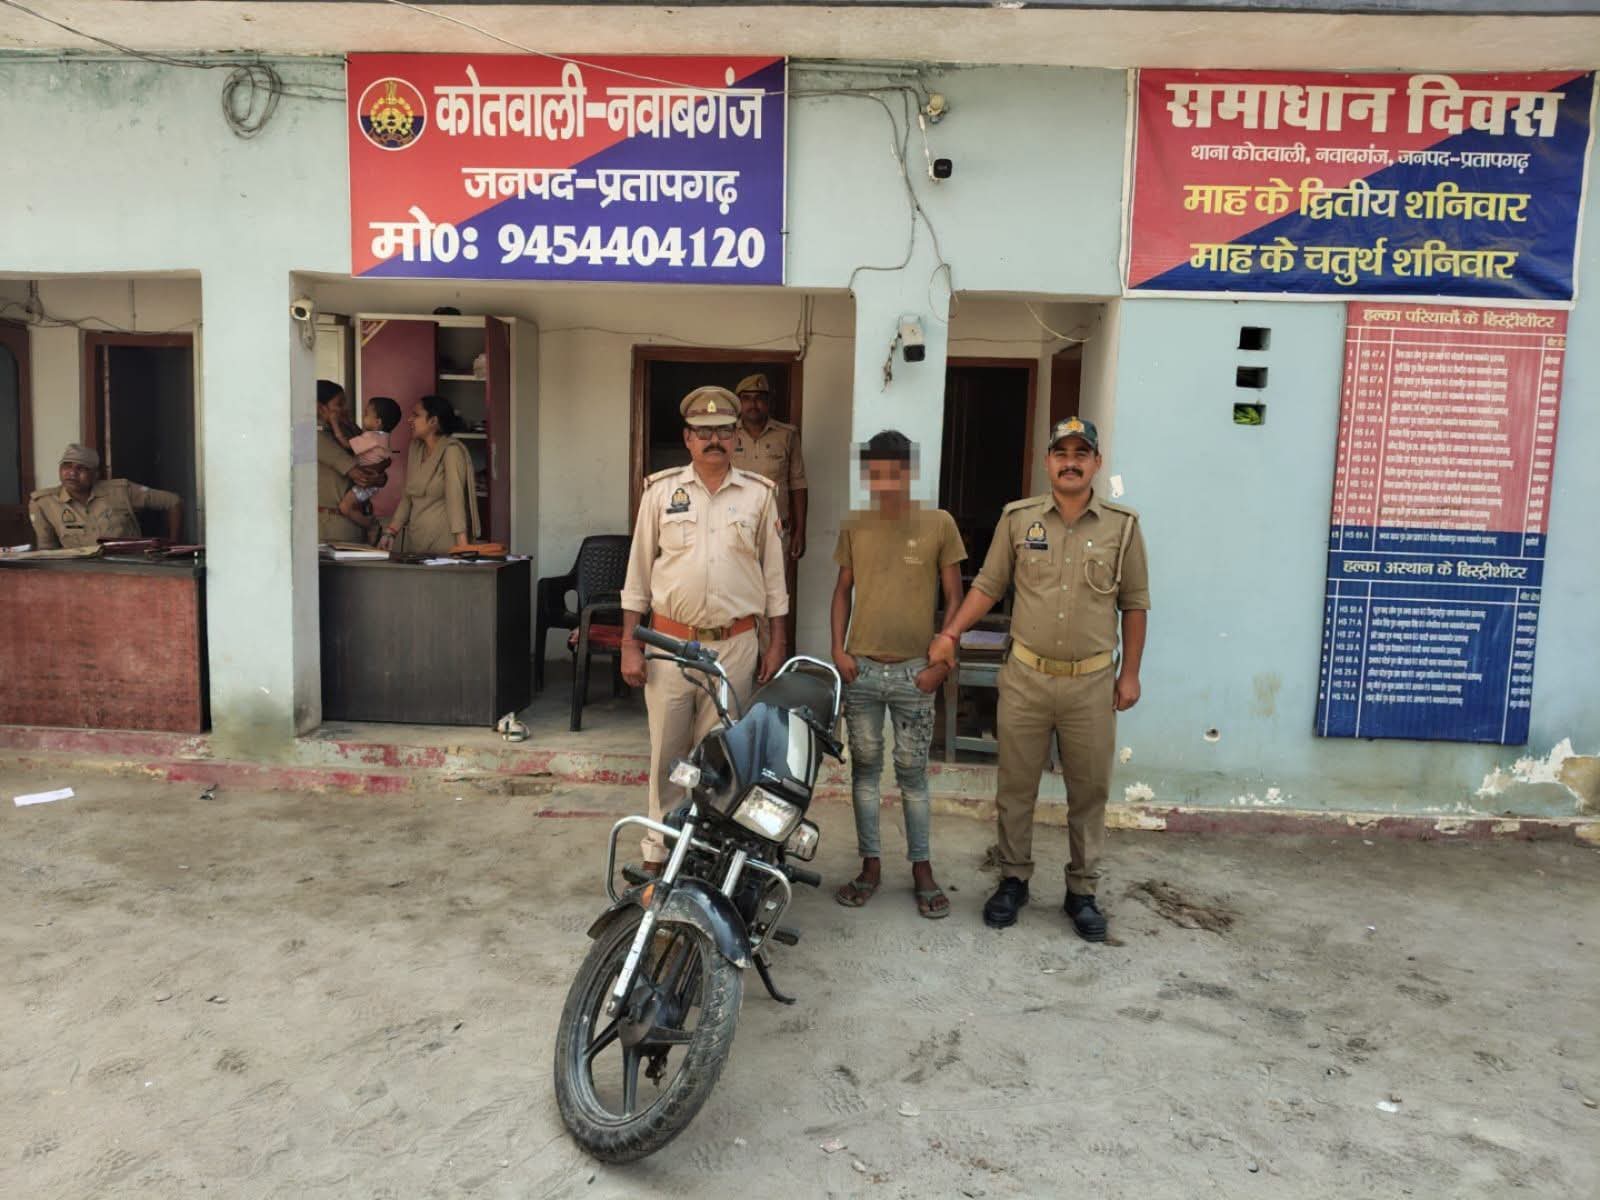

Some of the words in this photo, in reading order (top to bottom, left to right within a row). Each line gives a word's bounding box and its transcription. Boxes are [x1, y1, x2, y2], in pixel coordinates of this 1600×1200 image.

[434, 63, 765, 141] कोतवाली-नवाबगंज
[1166, 82, 1397, 133] समाधान
[1406, 74, 1565, 138] दिवस
[1191, 144, 1229, 161] थाना
[1231, 141, 1311, 165] कोतवाली,
[1316, 144, 1394, 167] नवाबगंज,
[1398, 150, 1531, 174] जनपद-प्रतापगढ़
[461, 167, 740, 215] जनपद-प्रतापगढ़
[1183, 184, 1248, 215] माह
[1254, 178, 1296, 216] के
[1298, 178, 1398, 220] द्वितीय
[1404, 181, 1532, 223] शनिवार
[498, 223, 765, 268] 9454404120
[1190, 242, 1253, 273] माह
[1257, 237, 1298, 274] के
[1304, 237, 1387, 286] चतुर्थ
[1392, 240, 1518, 280] शनिवार
[1462, 310, 1480, 325] के
[1343, 560, 1380, 573] हल्का
[1437, 560, 1453, 576] के
[1457, 561, 1528, 580] हिस्ट्रीशीटर
